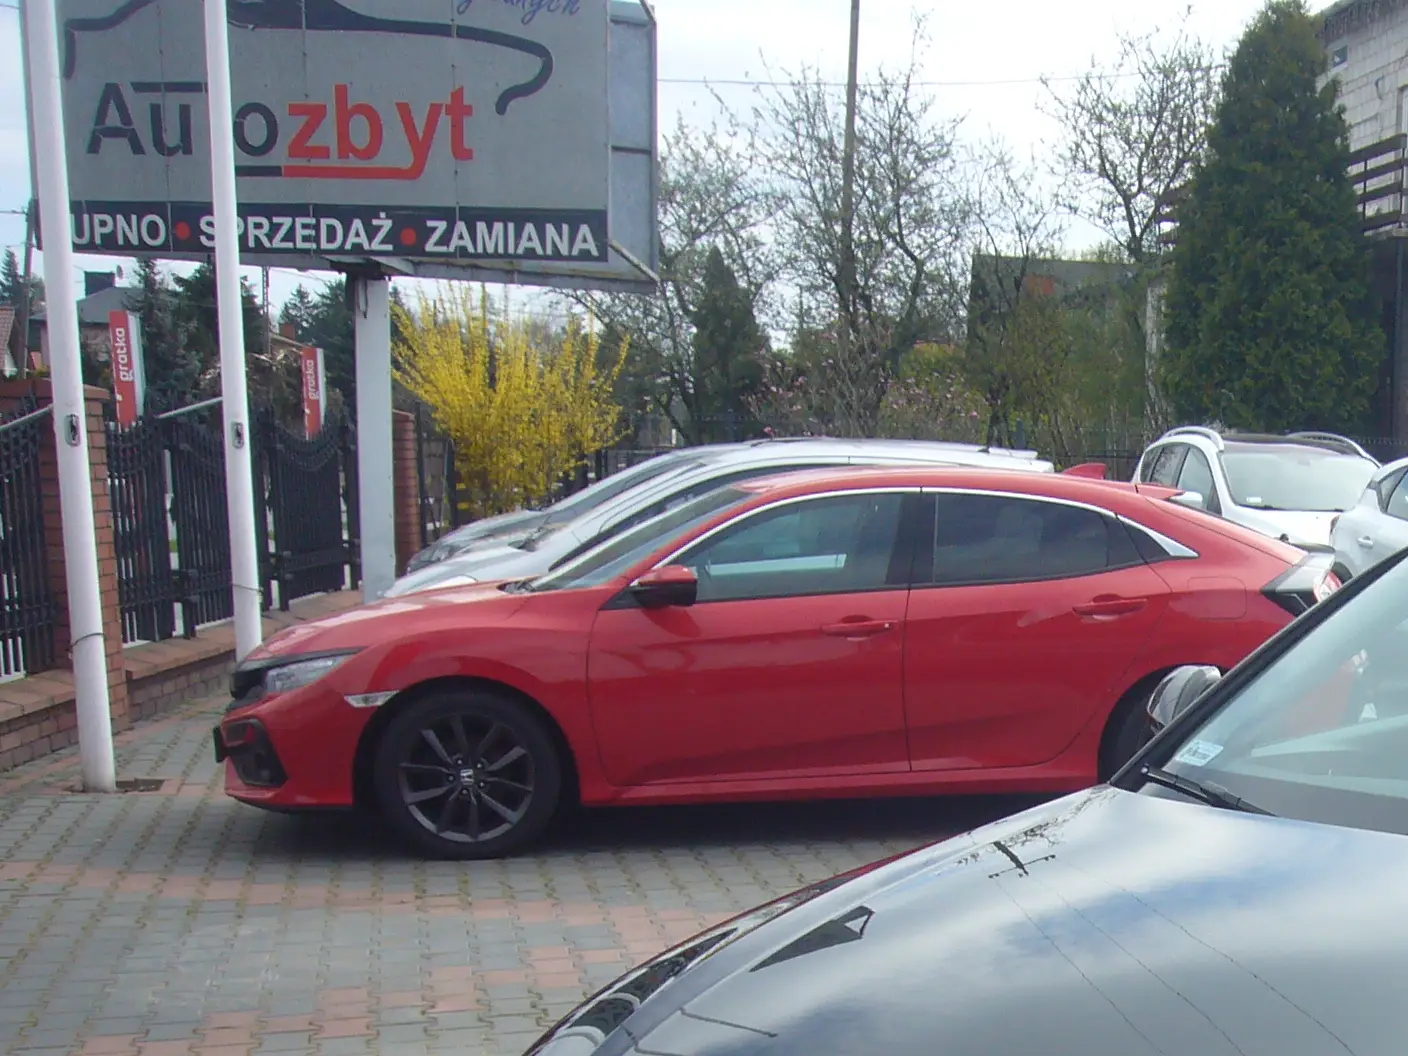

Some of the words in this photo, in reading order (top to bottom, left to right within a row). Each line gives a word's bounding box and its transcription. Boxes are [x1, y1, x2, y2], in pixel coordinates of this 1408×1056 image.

[86, 82, 473, 180] Auozbyt
[70, 213, 167, 247] UPNO
[425, 219, 600, 257] ZAMIANA
[115, 327, 134, 382] gratka
[306, 359, 320, 400] gratka
